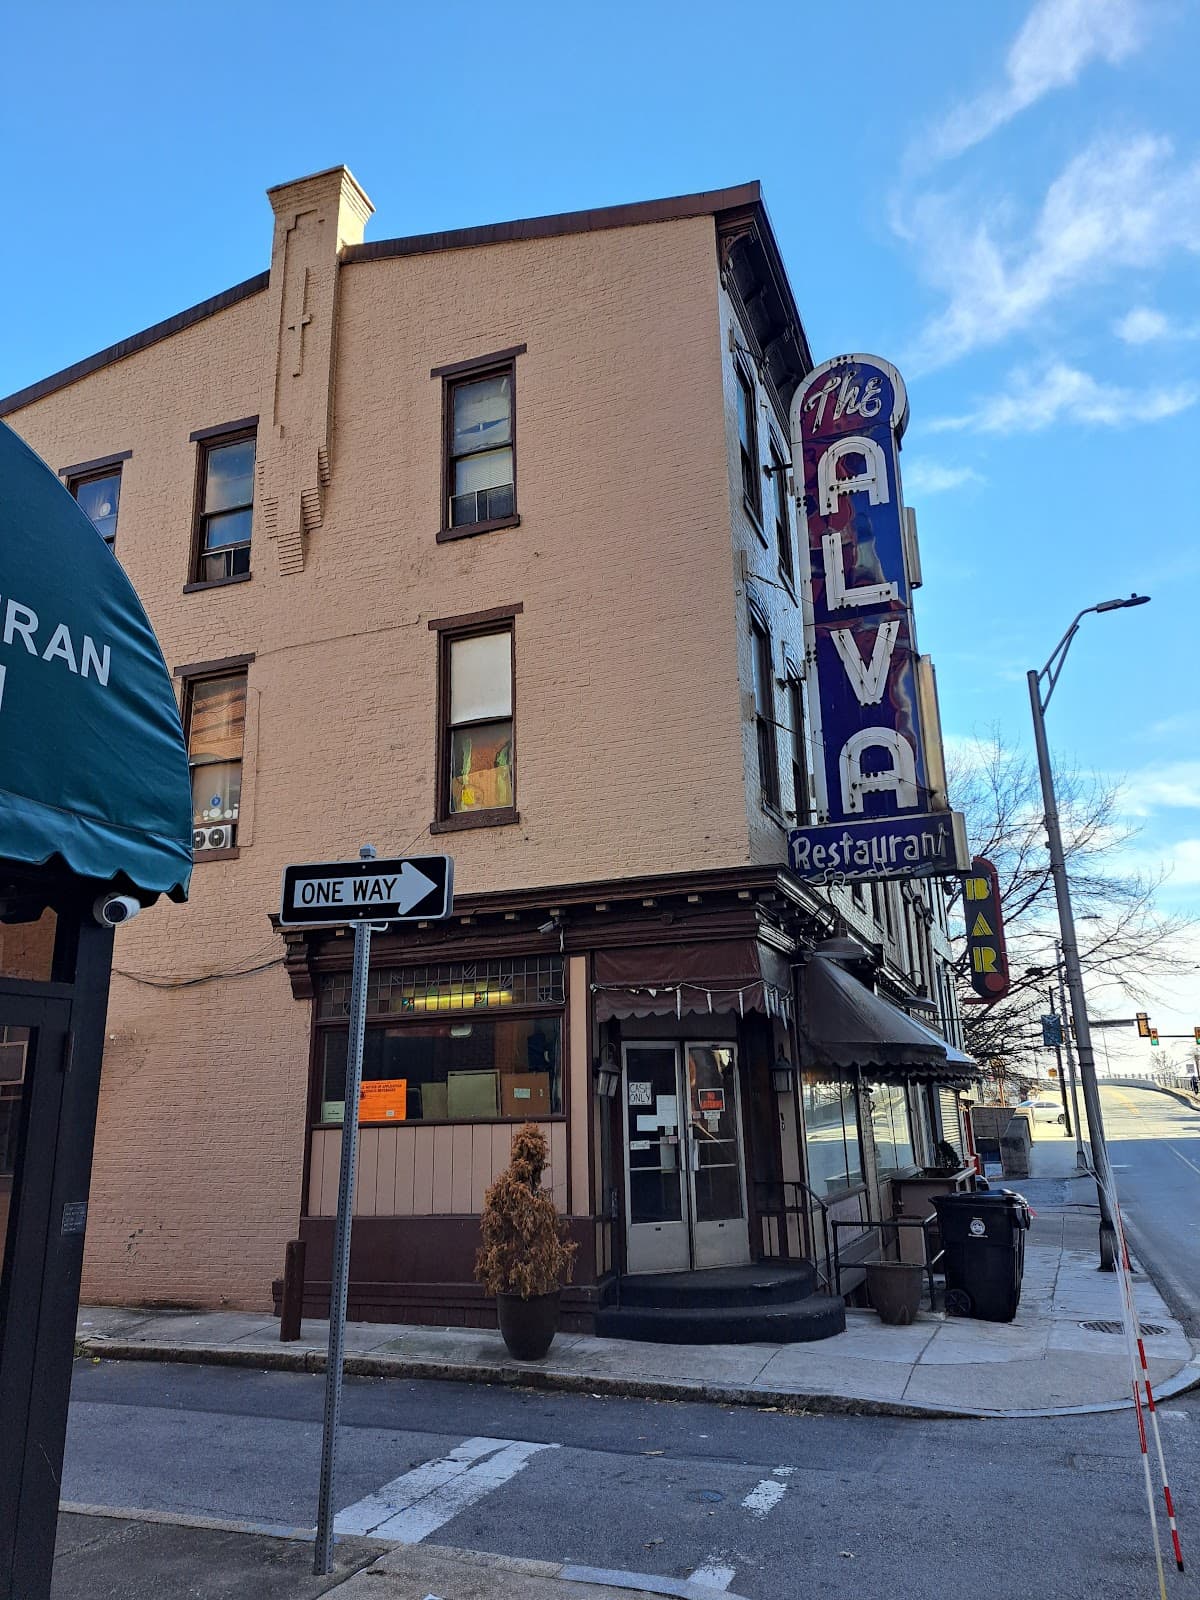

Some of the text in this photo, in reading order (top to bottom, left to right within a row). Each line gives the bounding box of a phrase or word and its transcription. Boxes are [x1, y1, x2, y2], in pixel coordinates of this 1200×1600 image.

[804, 370, 882, 434] The
[0, 597, 111, 687] RAN
[817, 436, 919, 815] ALVA
[791, 822, 950, 870] Restaurant
[301, 877, 397, 904] ONE WAY
[965, 877, 998, 973] BAR
[630, 1093, 650, 1102] ONLY
